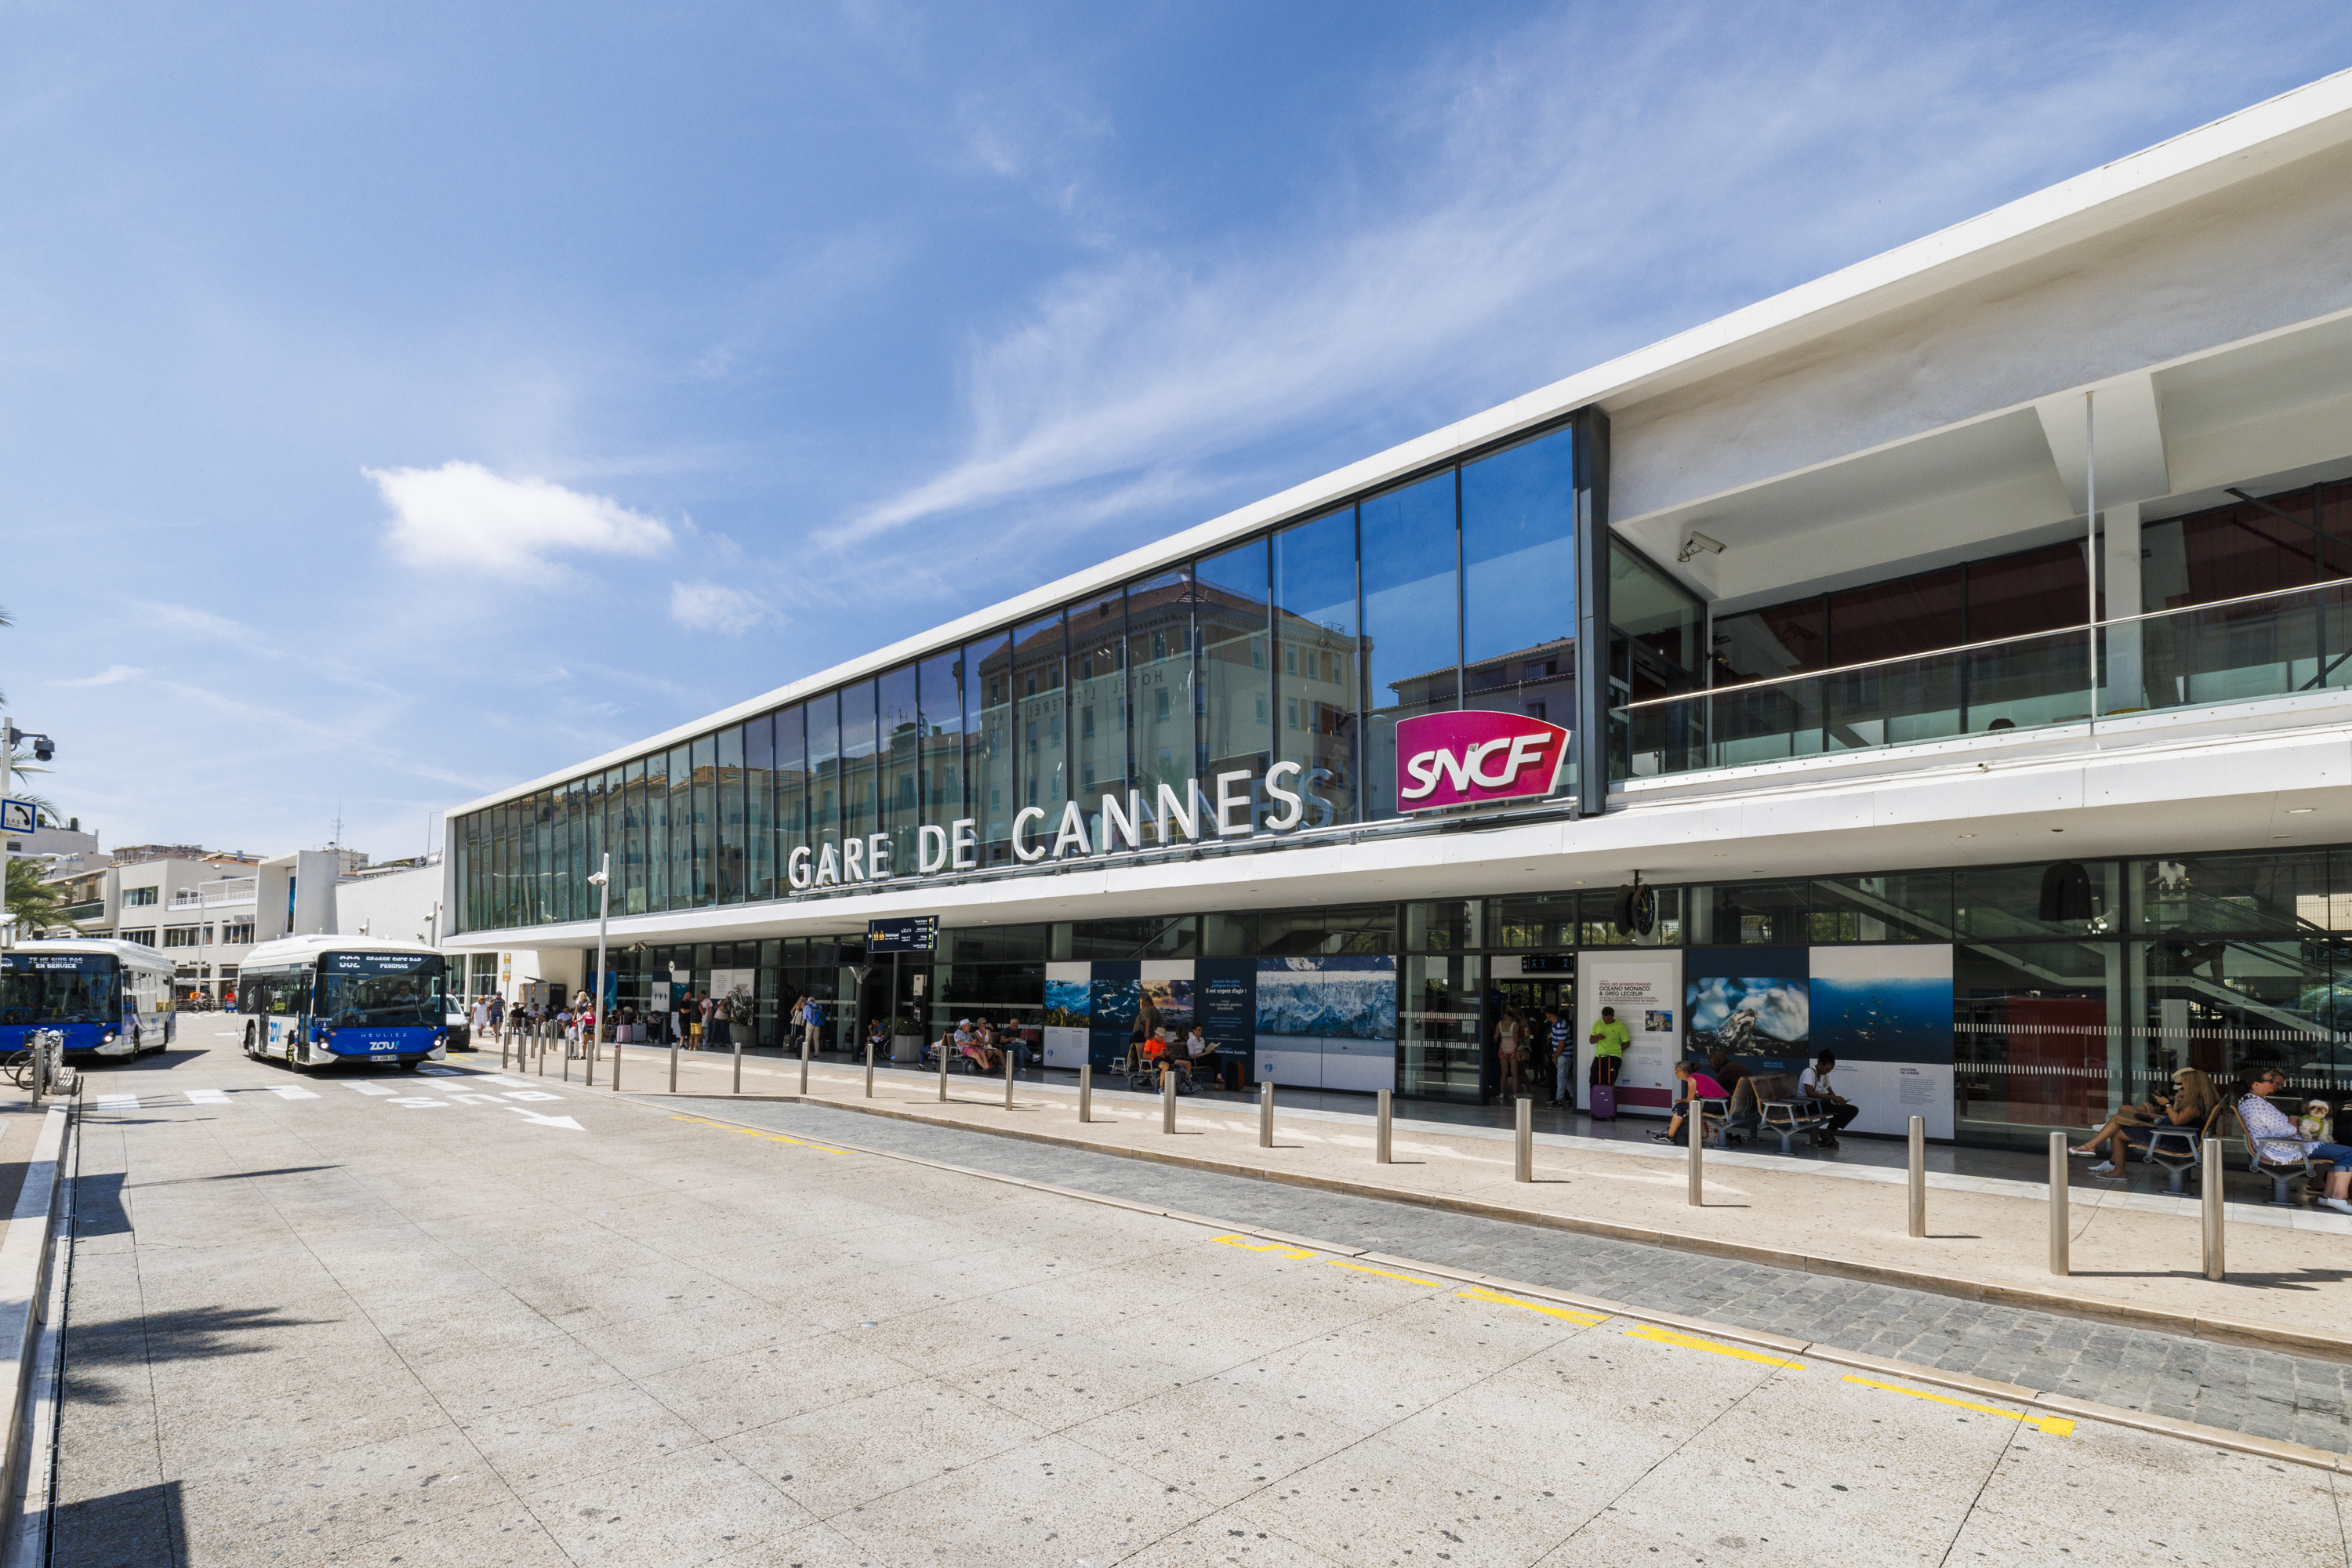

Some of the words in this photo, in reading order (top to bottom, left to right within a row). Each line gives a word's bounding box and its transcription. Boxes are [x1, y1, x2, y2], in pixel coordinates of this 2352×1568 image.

[1401, 732, 1552, 798] SNCF
[788, 833, 890, 889] GARE
[919, 818, 977, 873] DE
[1012, 760, 1303, 861] CANNES
[369, 1041, 399, 1050] ZOU!
